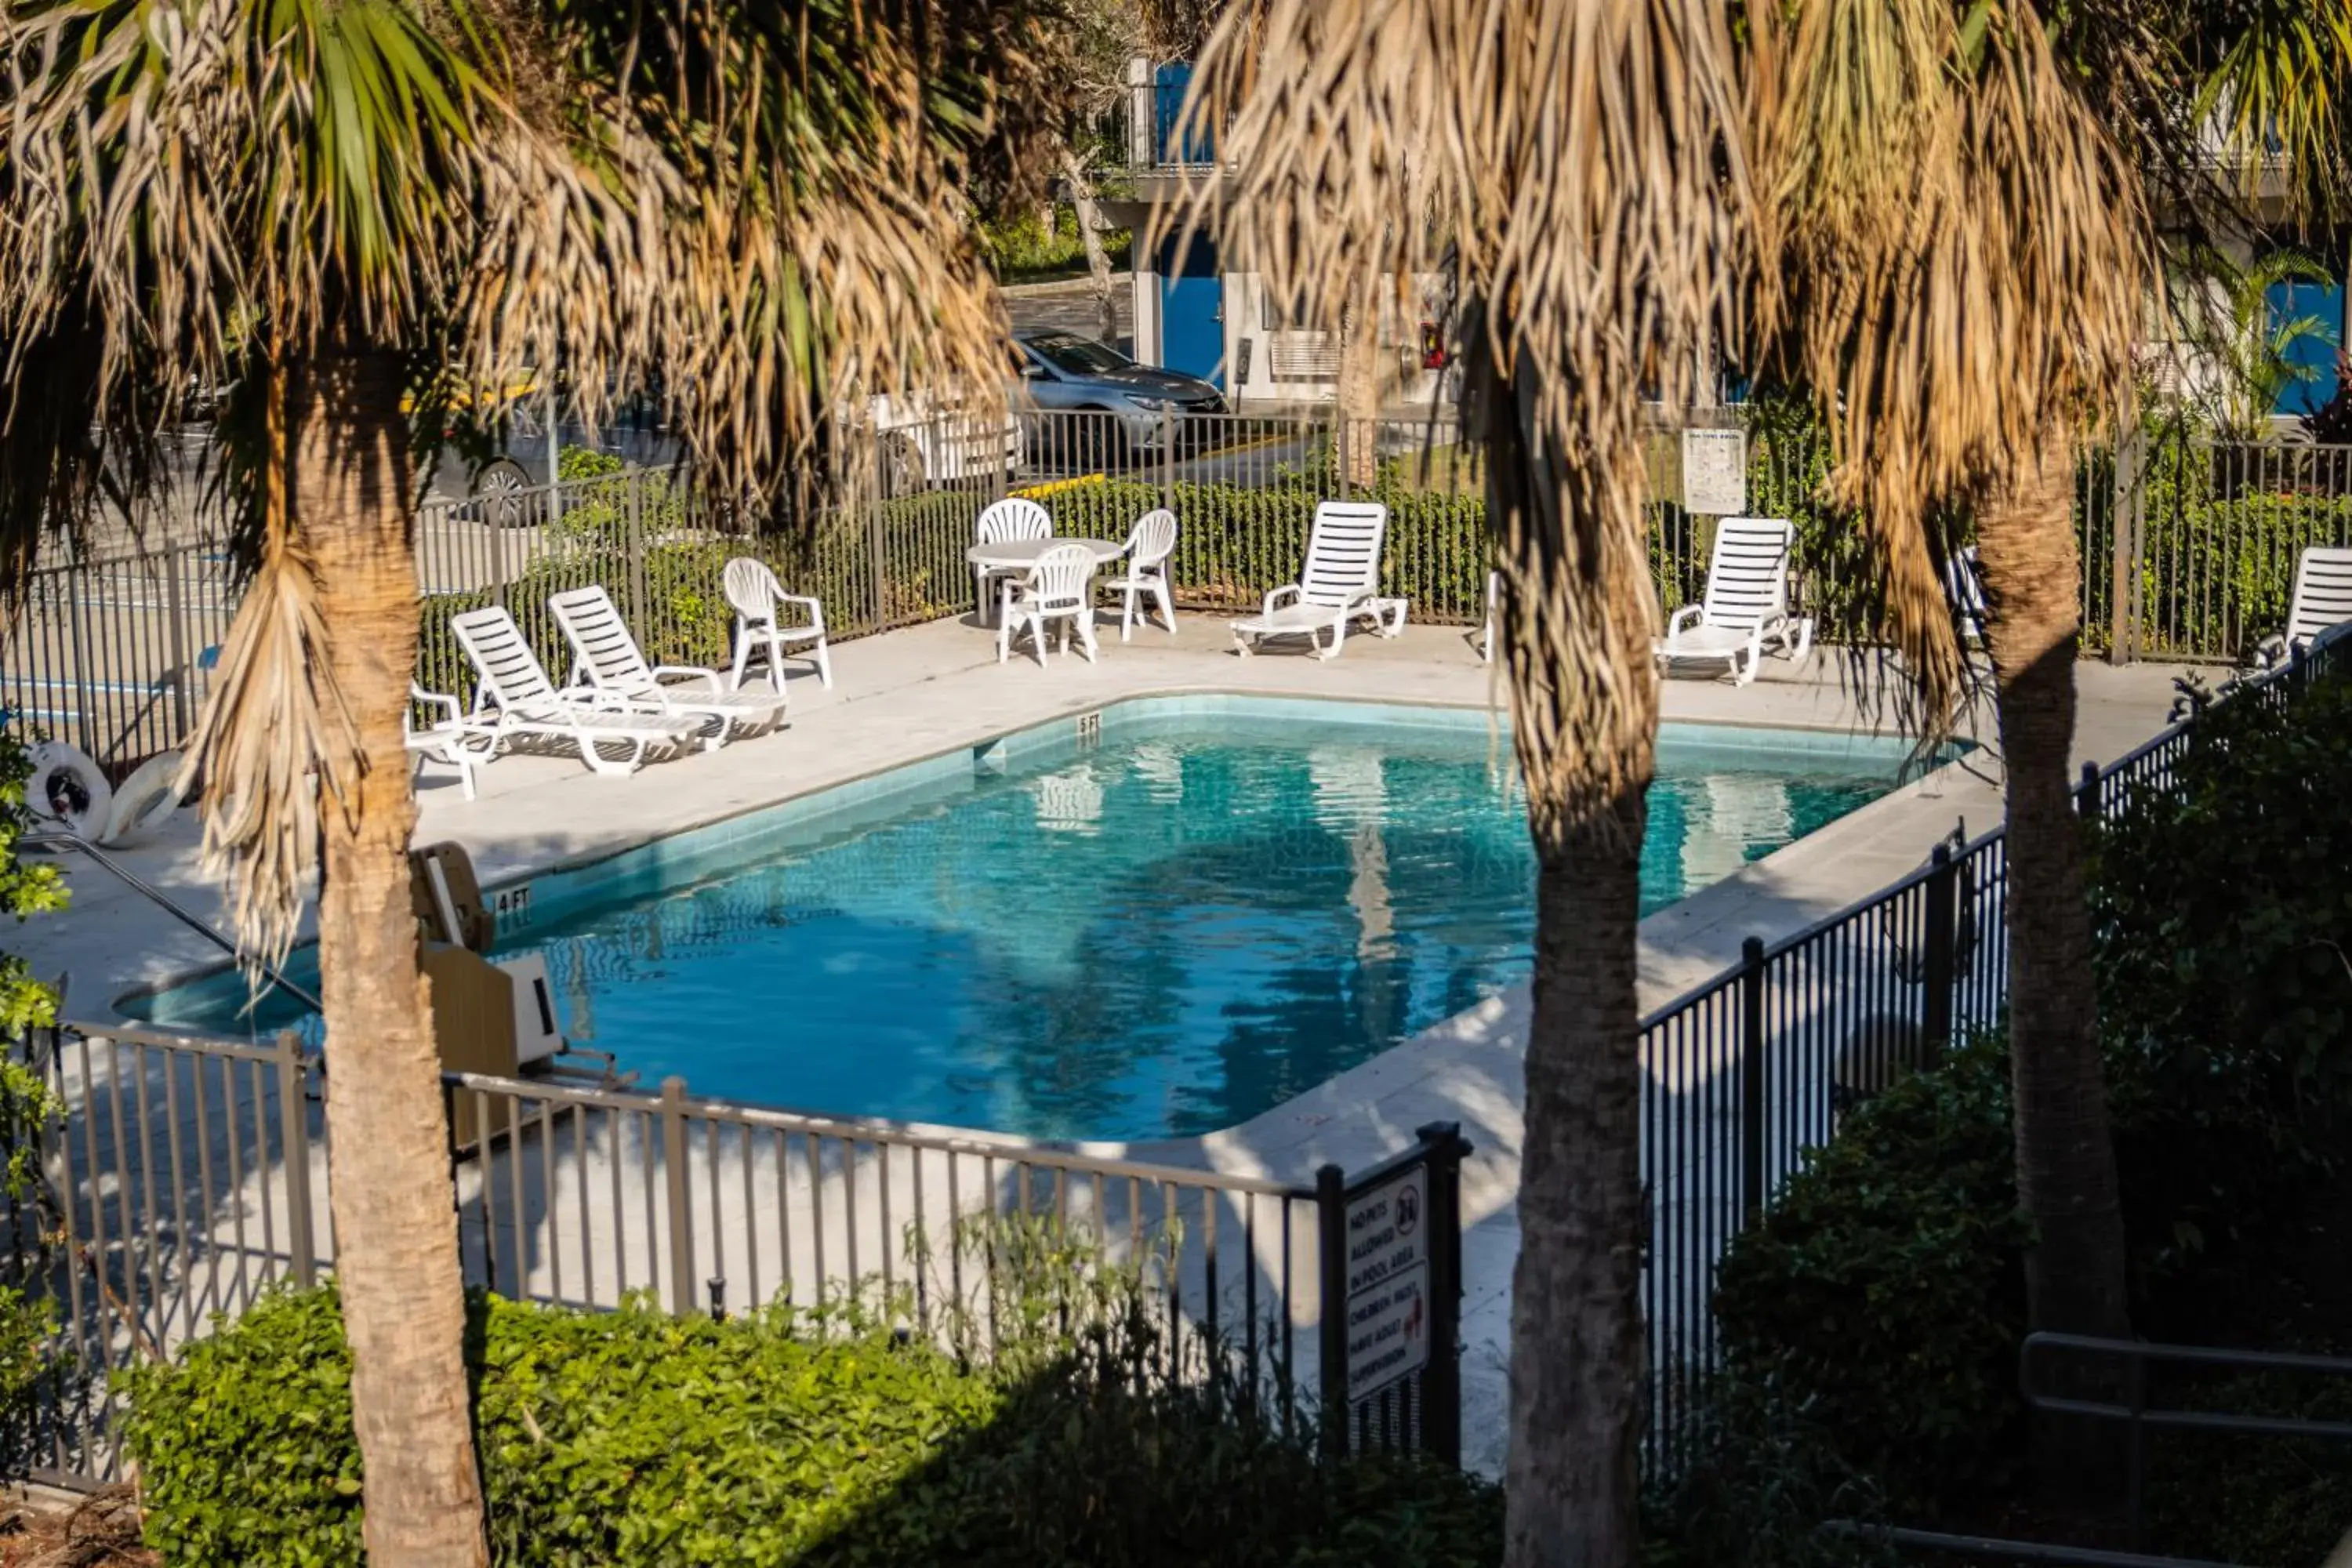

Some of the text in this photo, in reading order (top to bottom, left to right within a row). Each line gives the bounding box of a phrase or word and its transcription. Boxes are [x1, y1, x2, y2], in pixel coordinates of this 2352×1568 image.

[1080, 714, 1099, 733] 5 FT
[499, 887, 529, 913] 4 FT
[1351, 1200, 1388, 1229] NO PETS
[1351, 1226, 1395, 1261] ALLOWED
[1363, 1261, 1388, 1283] POOL
[1391, 1245, 1414, 1268] AREA
[1350, 1297, 1391, 1326] CHILDREN
